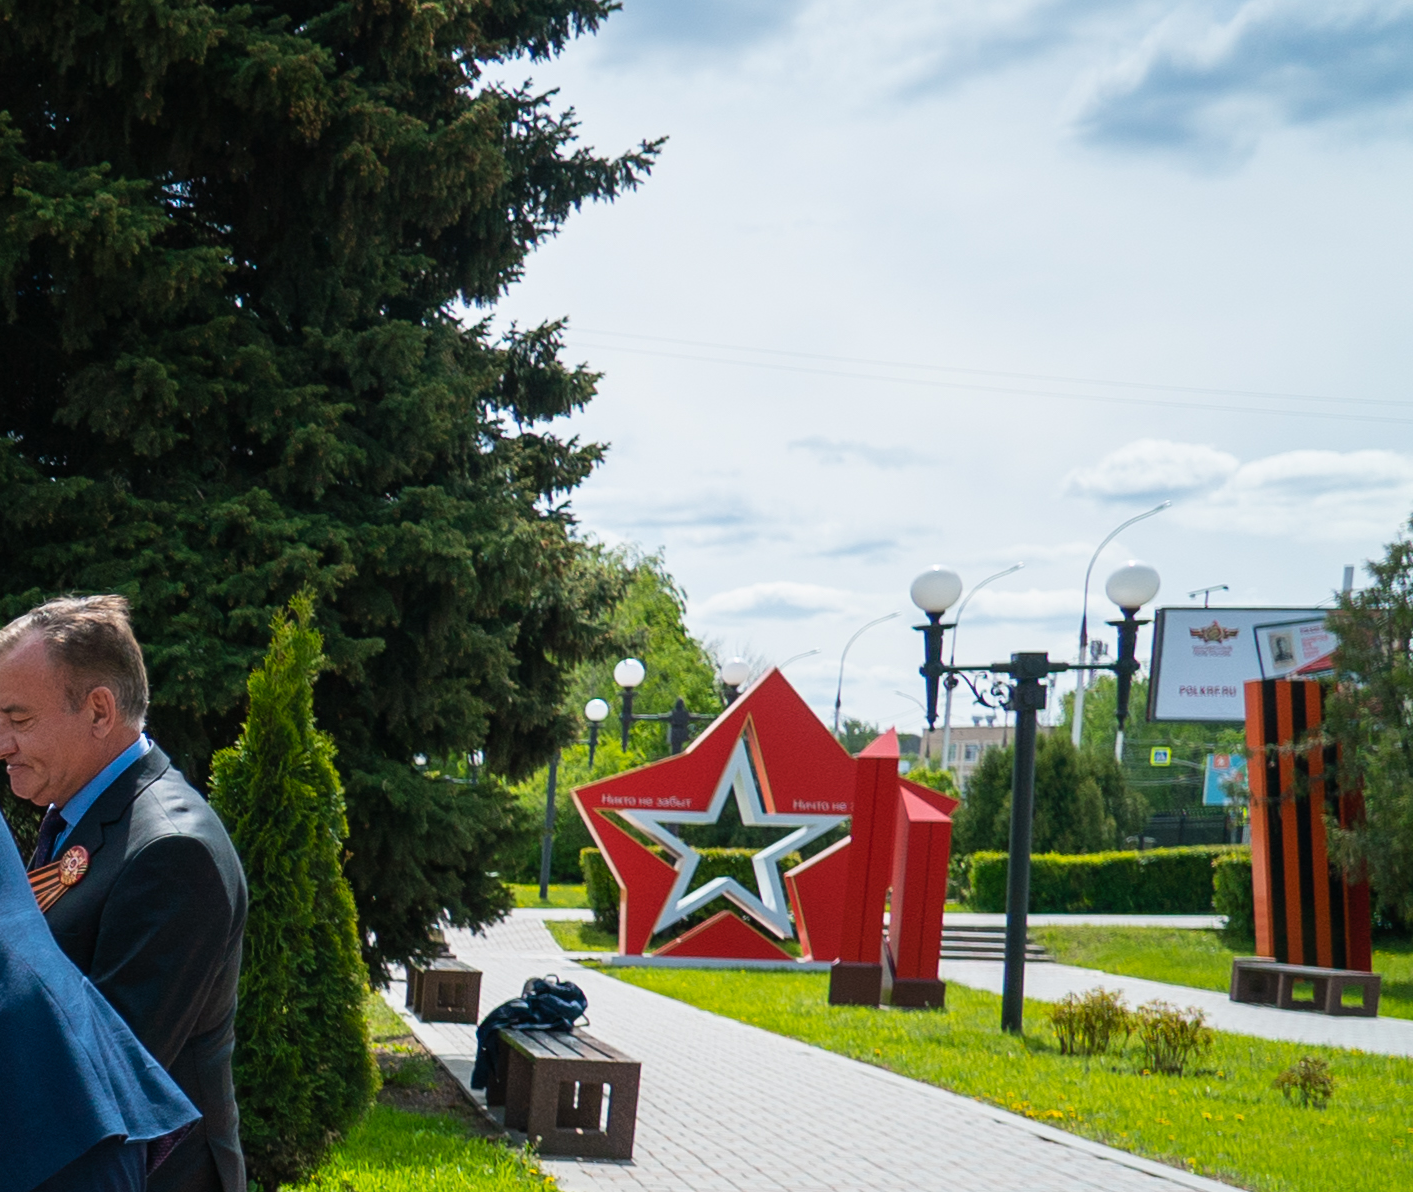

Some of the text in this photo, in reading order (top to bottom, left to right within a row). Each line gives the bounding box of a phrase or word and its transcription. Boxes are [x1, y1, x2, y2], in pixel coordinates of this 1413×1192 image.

[601, 793, 693, 809] Никто не забыт
[793, 799, 829, 811] Ничто
[832, 802, 847, 812] не
